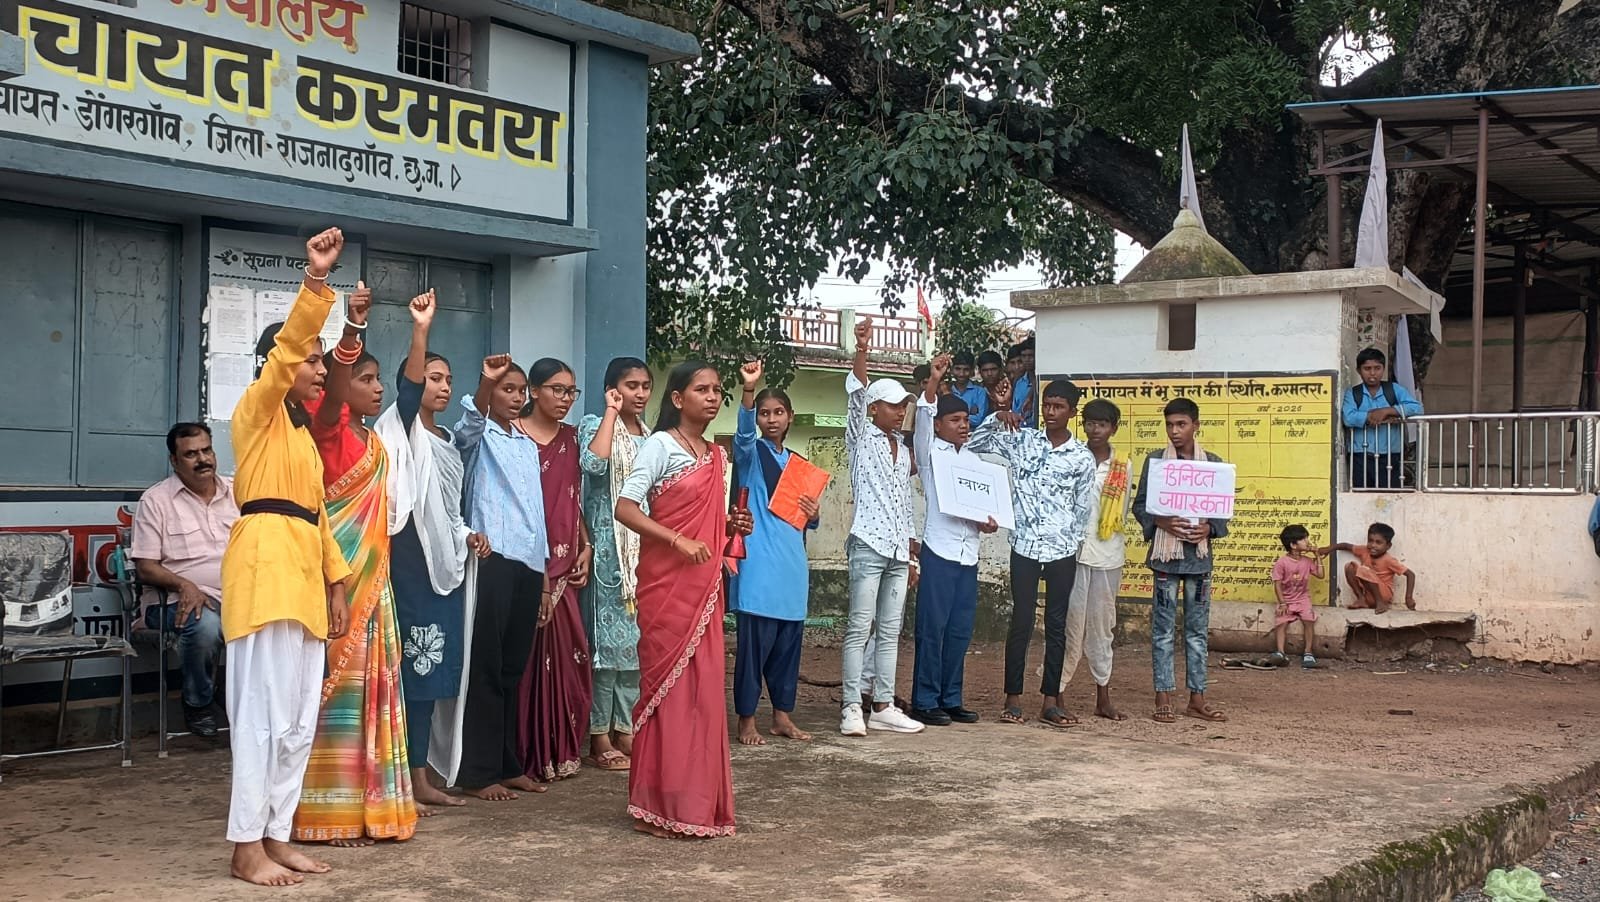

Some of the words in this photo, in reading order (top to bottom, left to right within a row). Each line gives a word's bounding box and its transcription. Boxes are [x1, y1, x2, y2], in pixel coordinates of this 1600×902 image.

[0, 0, 274, 110] चायत
[296, 55, 561, 164] करमतरा
[243, 252, 282, 273] सूचना
[285, 256, 310, 270] पट
[1091, 382, 1137, 400] पंचायत
[1140, 381, 1153, 398] में
[1155, 385, 1169, 400] भू
[1171, 385, 1201, 399] जल
[1203, 381, 1221, 397] की
